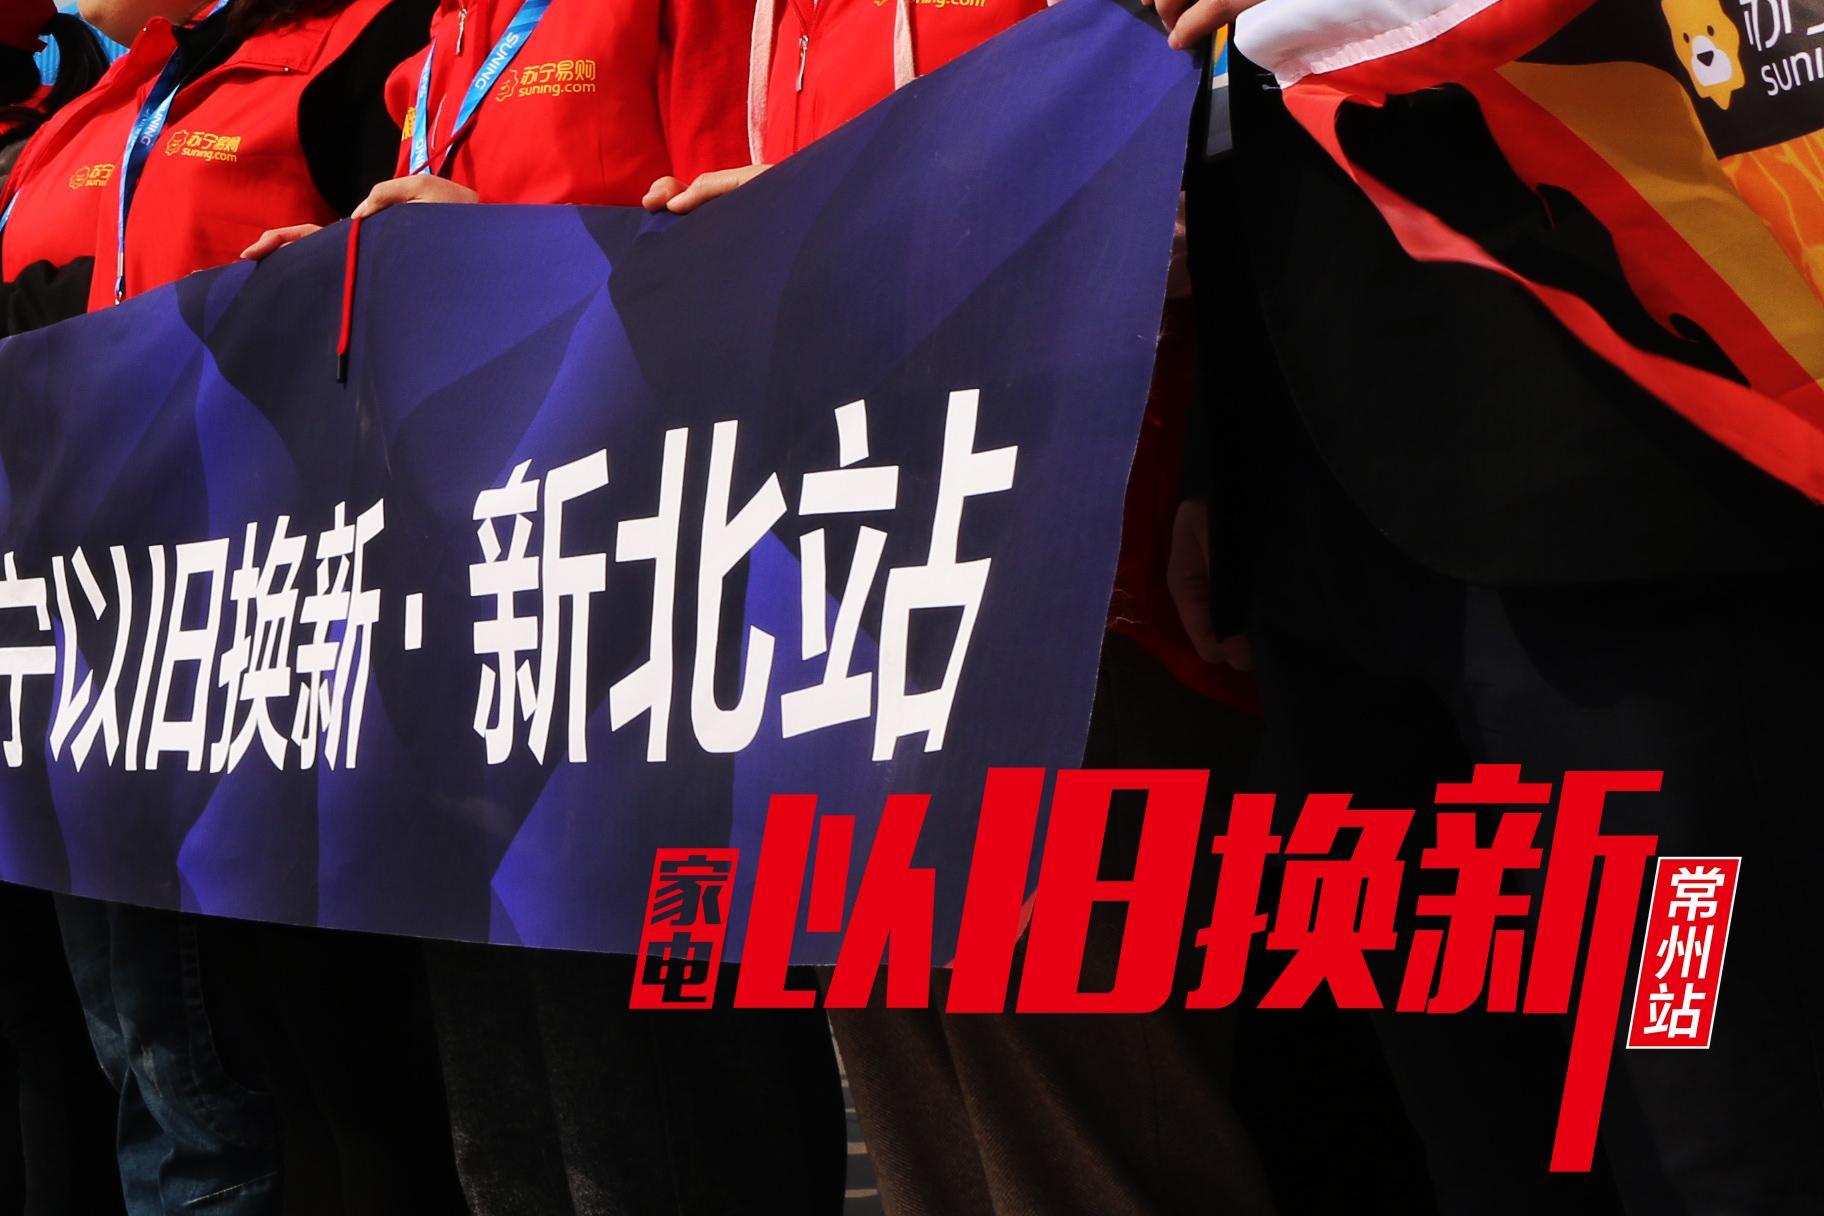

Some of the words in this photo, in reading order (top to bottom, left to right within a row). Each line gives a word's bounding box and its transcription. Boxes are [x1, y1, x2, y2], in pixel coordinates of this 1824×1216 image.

[474, 31, 520, 91] SUNING
[520, 59, 597, 85] 苏宁易购
[519, 82, 596, 97] suning.com
[181, 147, 238, 163] suning.com
